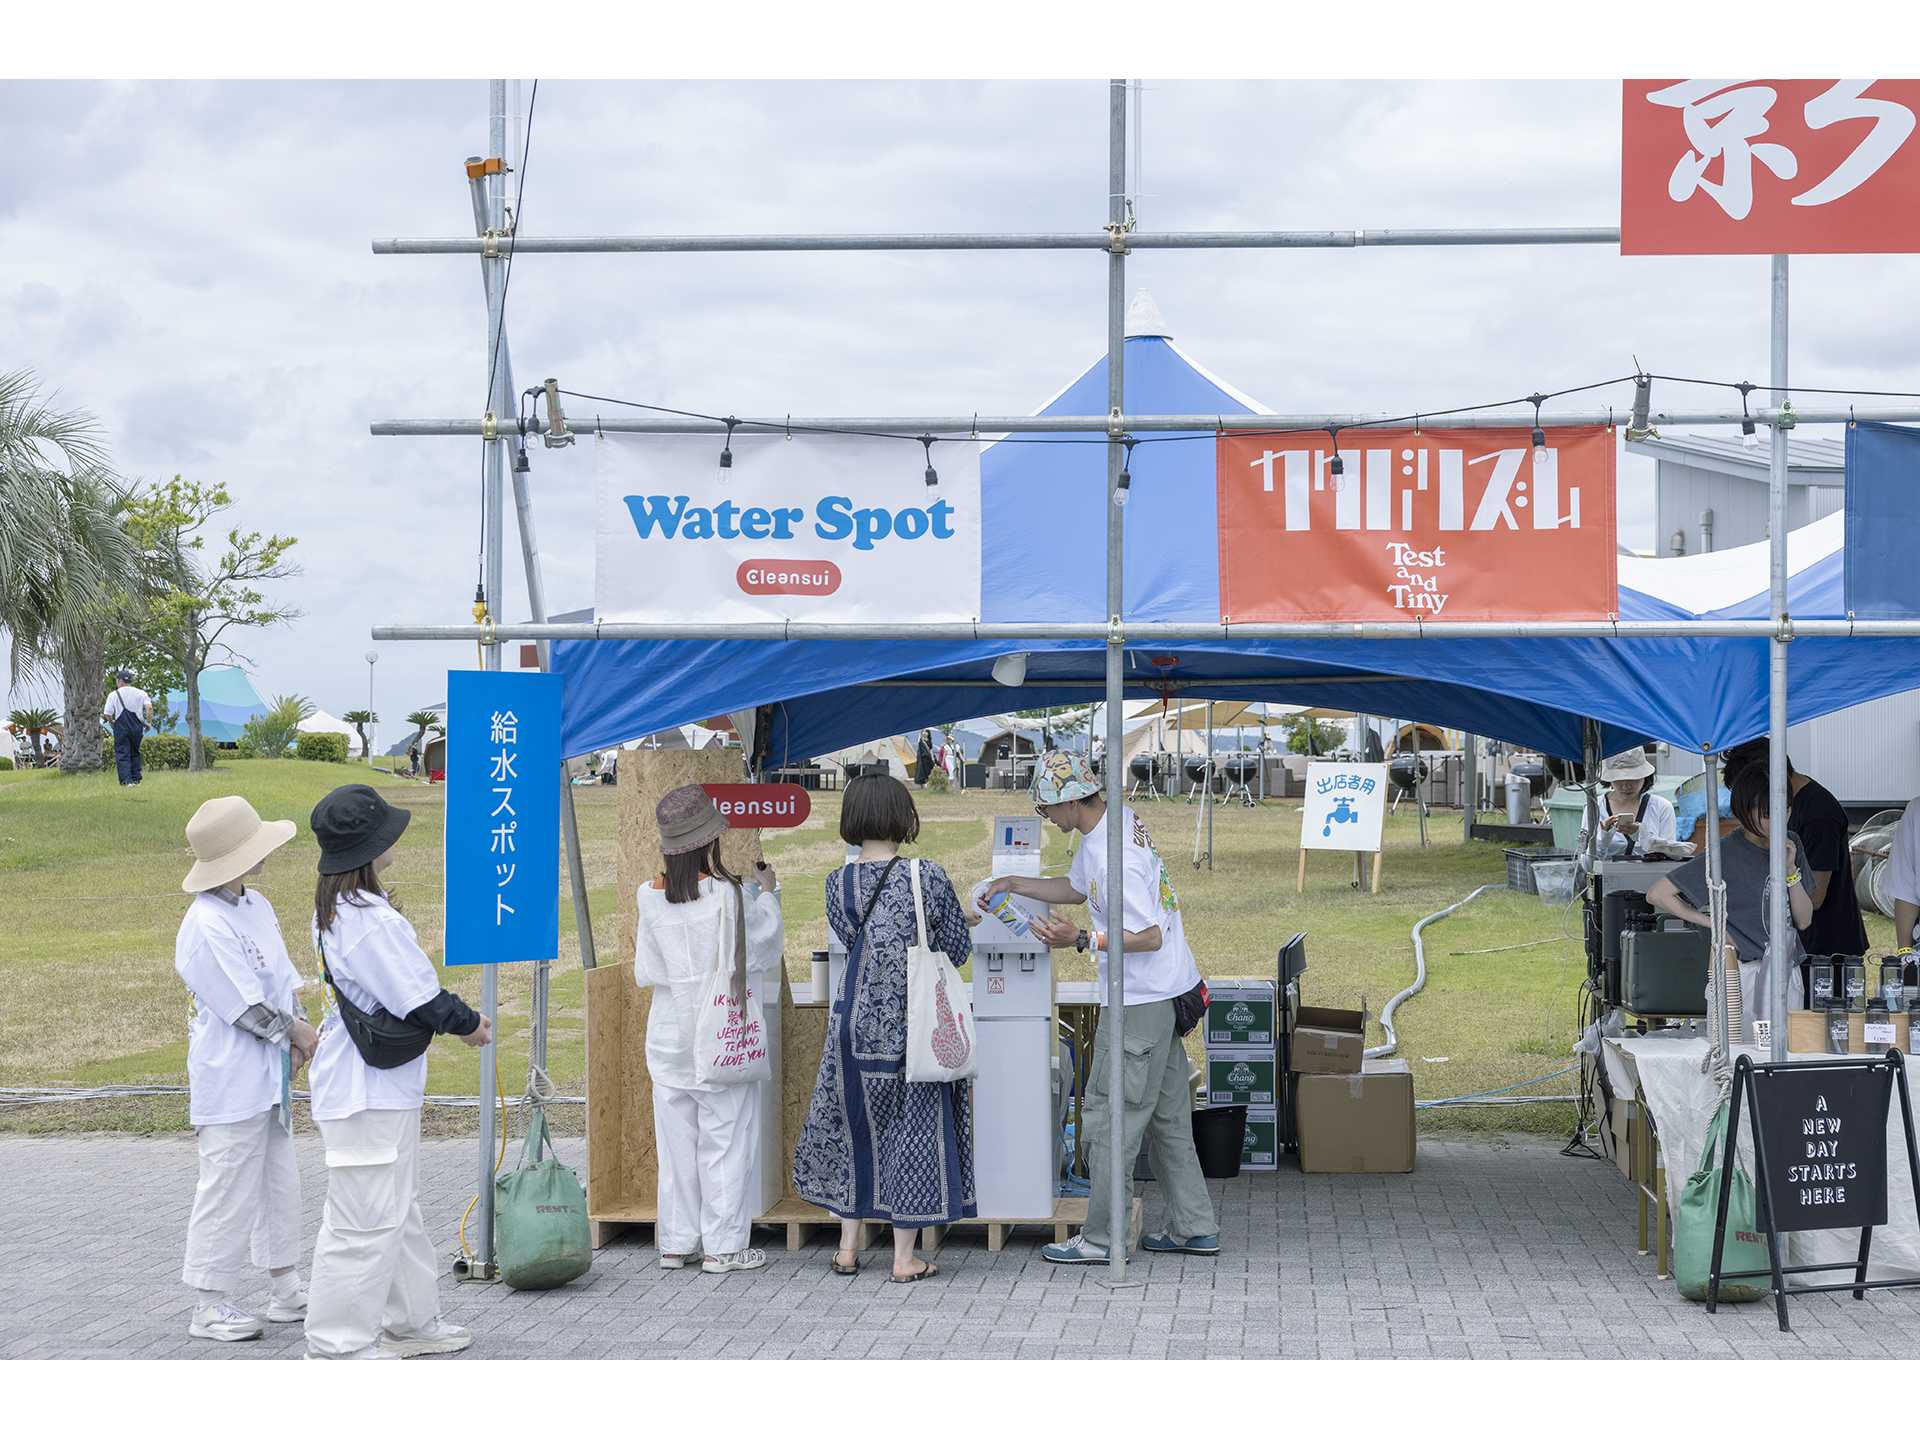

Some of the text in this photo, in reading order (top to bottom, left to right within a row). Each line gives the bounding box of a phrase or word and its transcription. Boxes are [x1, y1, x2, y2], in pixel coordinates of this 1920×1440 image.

[623, 495, 956, 551] Water Spot
[1386, 542, 1446, 567] Test
[746, 568, 830, 587] Cleansui
[1396, 565, 1438, 592] and
[1386, 584, 1449, 614] Tiny
[1316, 774, 1376, 796] 出店者用
[712, 795, 797, 815] leansui
[490, 710, 519, 926] 給水スポット
[1816, 1095, 1828, 1112] A
[1802, 1118, 1841, 1135] NEW
[1806, 1140, 1839, 1158] DAY
[1788, 1163, 1857, 1182] STARTS
[1800, 1186, 1846, 1206] HERE
